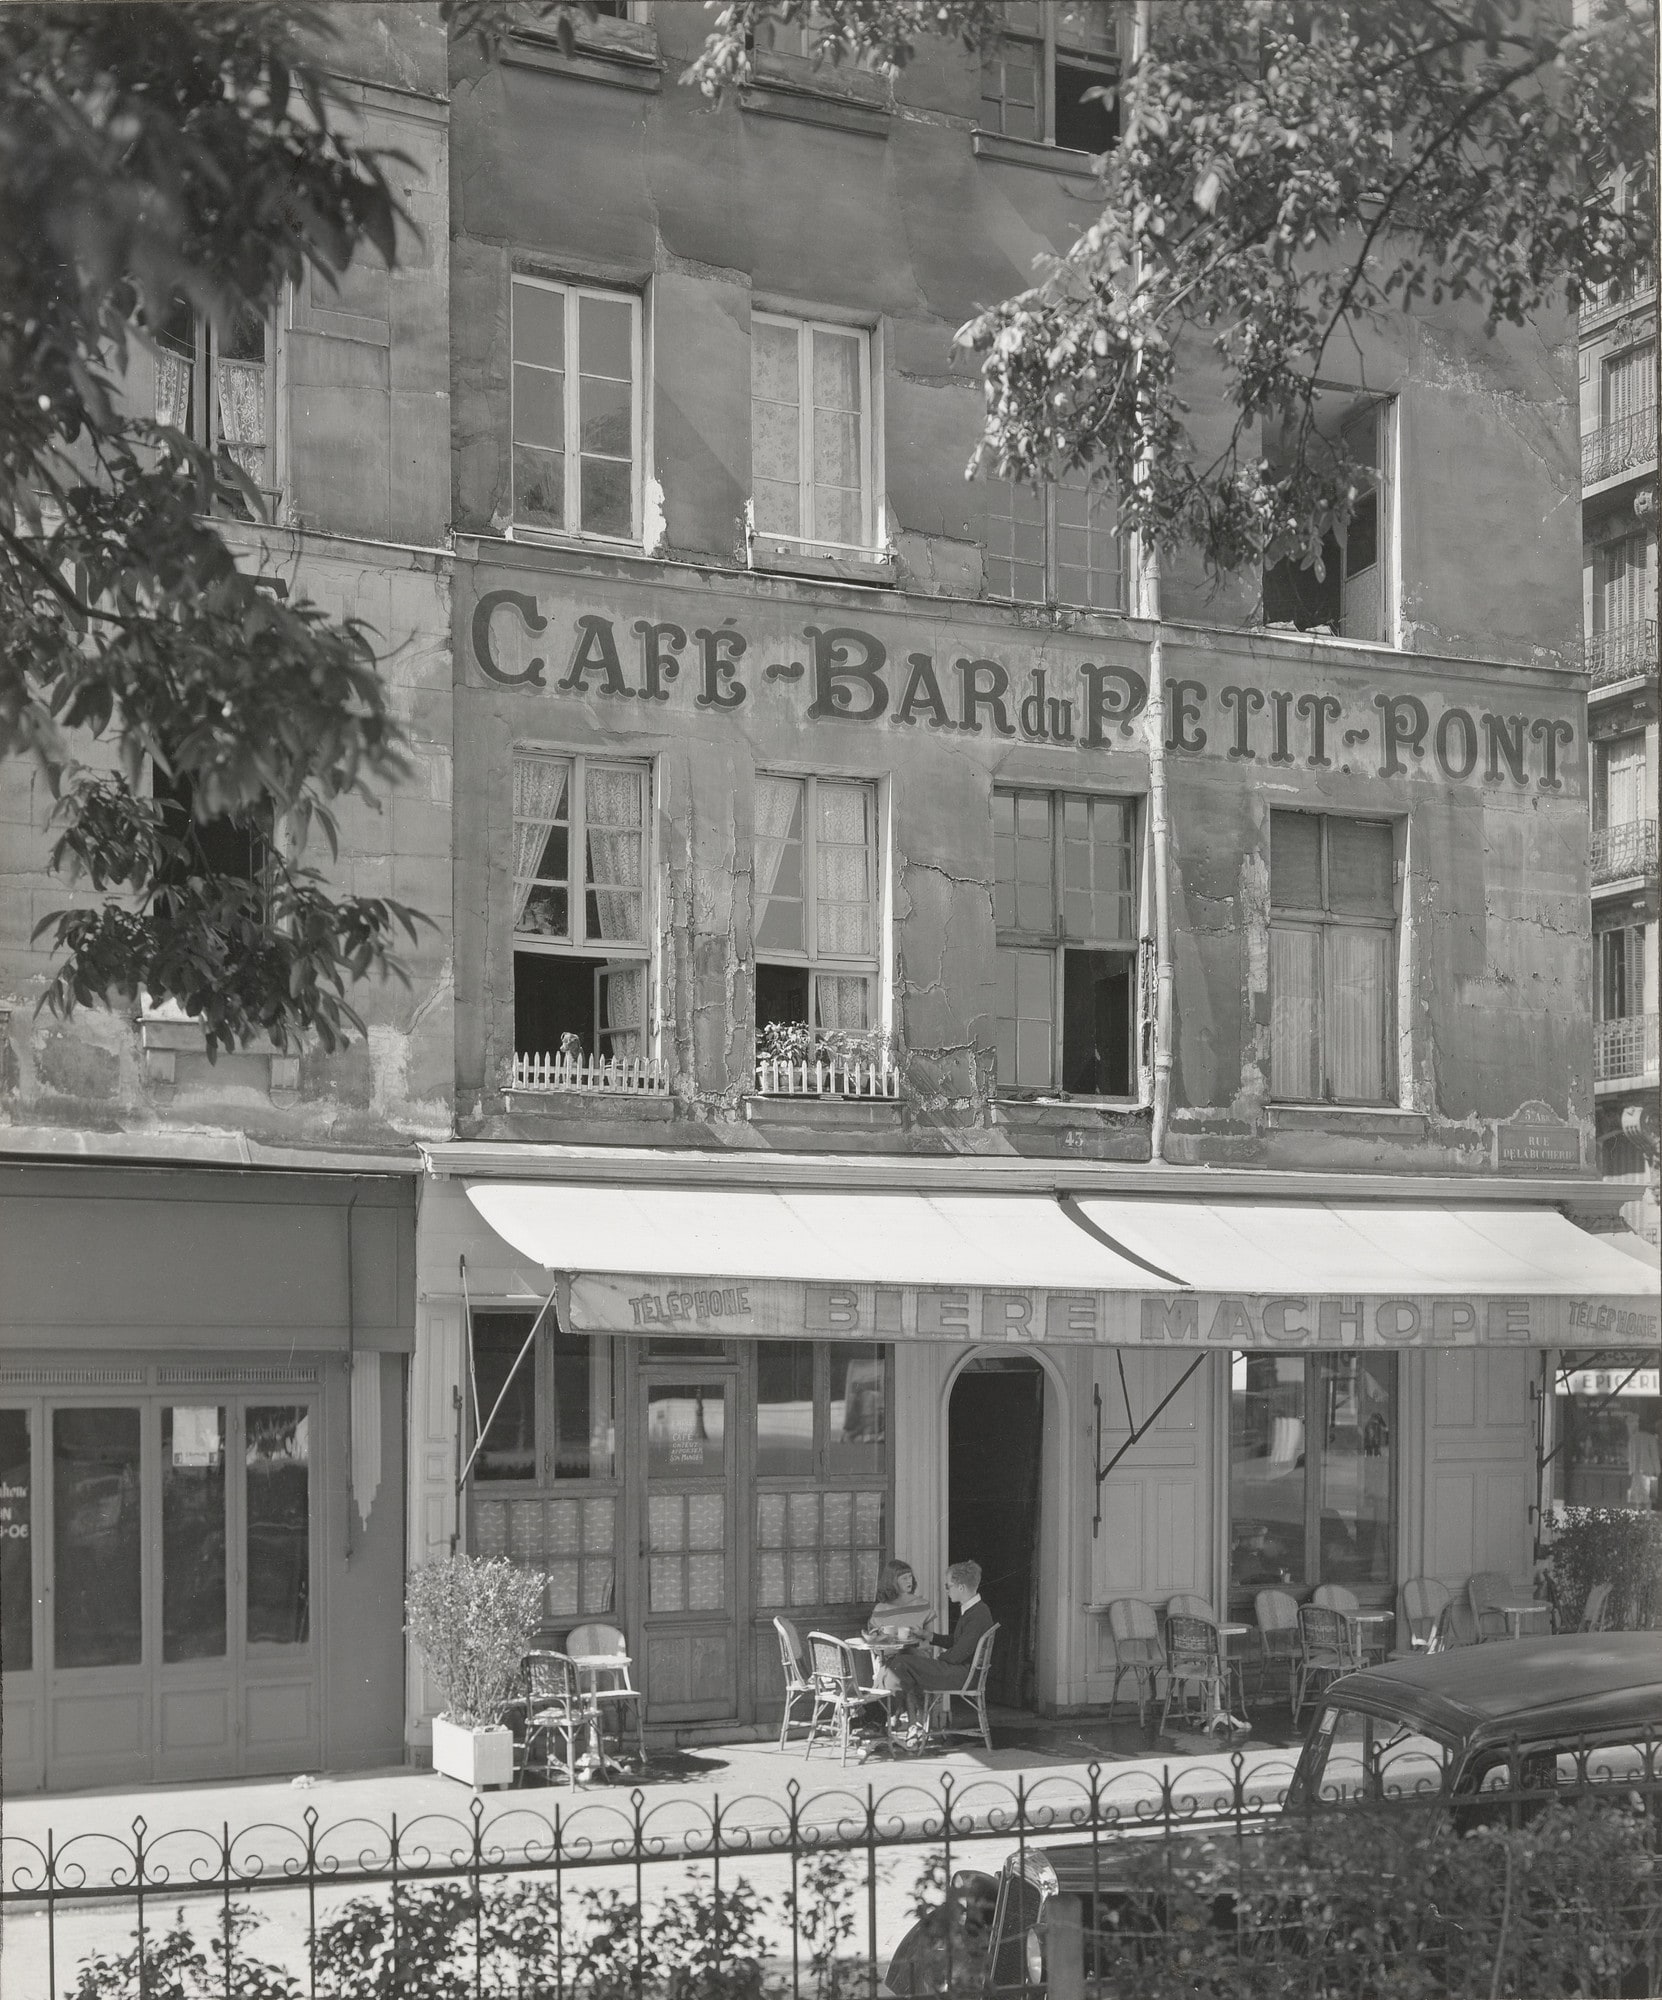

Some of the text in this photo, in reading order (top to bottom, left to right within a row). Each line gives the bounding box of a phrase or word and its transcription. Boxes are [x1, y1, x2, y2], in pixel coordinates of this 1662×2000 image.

[1020, 668, 1074, 742] du
[1064, 1130, 1084, 1147] 43
[1528, 1136, 1551, 1147] RUE
[628, 1286, 752, 1325] TÉLÉPHONE
[1140, 1298, 1532, 1341] MACHOPE
